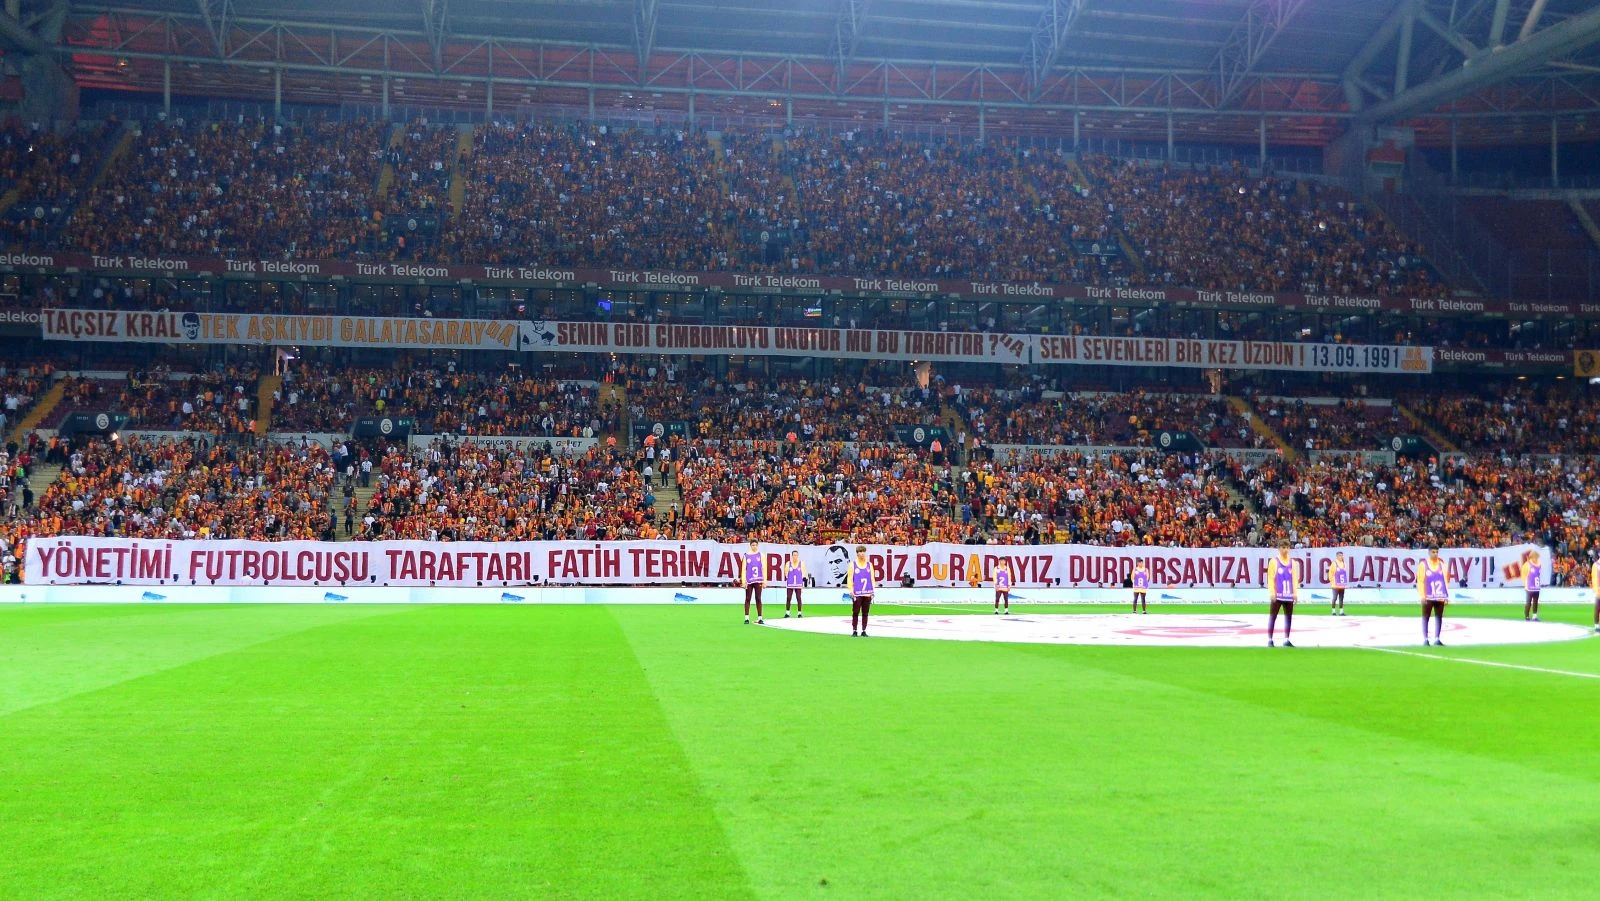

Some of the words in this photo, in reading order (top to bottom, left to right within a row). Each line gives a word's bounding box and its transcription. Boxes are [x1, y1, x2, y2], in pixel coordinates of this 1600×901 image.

[0, 253, 54, 266] elekom
[92, 256, 123, 268] Türk
[128, 256, 188, 270] Telekom
[225, 260, 256, 272] Türk
[261, 260, 320, 274] Telekom
[356, 263, 387, 276] Türk
[390, 264, 449, 277] Telekom
[484, 266, 514, 279] Türk
[518, 268, 575, 281] Telekom
[610, 270, 640, 282] Türk
[643, 272, 699, 284] Telekom
[733, 274, 762, 286] Türk
[766, 276, 820, 288] Telekom
[853, 278, 881, 290] Türk
[885, 279, 939, 292] Telekom
[970, 282, 998, 294] Türk
[1002, 283, 1054, 296] Telekom
[1084, 286, 1112, 298] Türk
[1115, 288, 1166, 300] Telekom
[1196, 290, 1222, 302] Türk
[1226, 292, 1275, 304] Telekom
[1304, 294, 1330, 306] Türk
[1333, 296, 1381, 308] Telekom
[1409, 298, 1434, 310] Türk
[1436, 299, 1484, 312] Telekom
[1508, 302, 1528, 312] Türk
[1531, 303, 1569, 313] Telekom
[0, 311, 41, 323] eleko
[44, 310, 118, 338] TAÇSIZ
[126, 312, 182, 338] KRAL
[200, 315, 240, 339] TEK
[340, 318, 487, 346] GALATASARAY
[774, 327, 840, 351] UNUTUR
[846, 329, 872, 353] MU
[877, 330, 899, 354] BU
[904, 332, 984, 356] TARAFTAR
[1040, 335, 1077, 360] SENİ
[1082, 338, 1170, 362] SEVENLERİ
[1176, 340, 1202, 364] BİR
[1208, 342, 1238, 365] KEZ
[1243, 340, 1294, 366] ÜZDÜN
[1312, 345, 1398, 368] 13.09.1991
[1438, 350, 1486, 362] Telekom
[1504, 352, 1524, 362] Türk
[1527, 352, 1565, 362] Telekom
[548, 544, 620, 578] FATİH
[628, 544, 710, 578] TERİM
[869, 549, 908, 582] BİZ
[1258, 552, 1311, 584] HDİ
[752, 567, 758, 578] 3
[793, 575, 797, 584] 1
[1340, 574, 1344, 584] 5
[860, 578, 868, 591] 7
[998, 576, 1005, 586] 2
[1138, 577, 1143, 586] 8
[1282, 580, 1290, 594] 11
[1430, 580, 1443, 596] 12
[1534, 576, 1540, 586] 6
